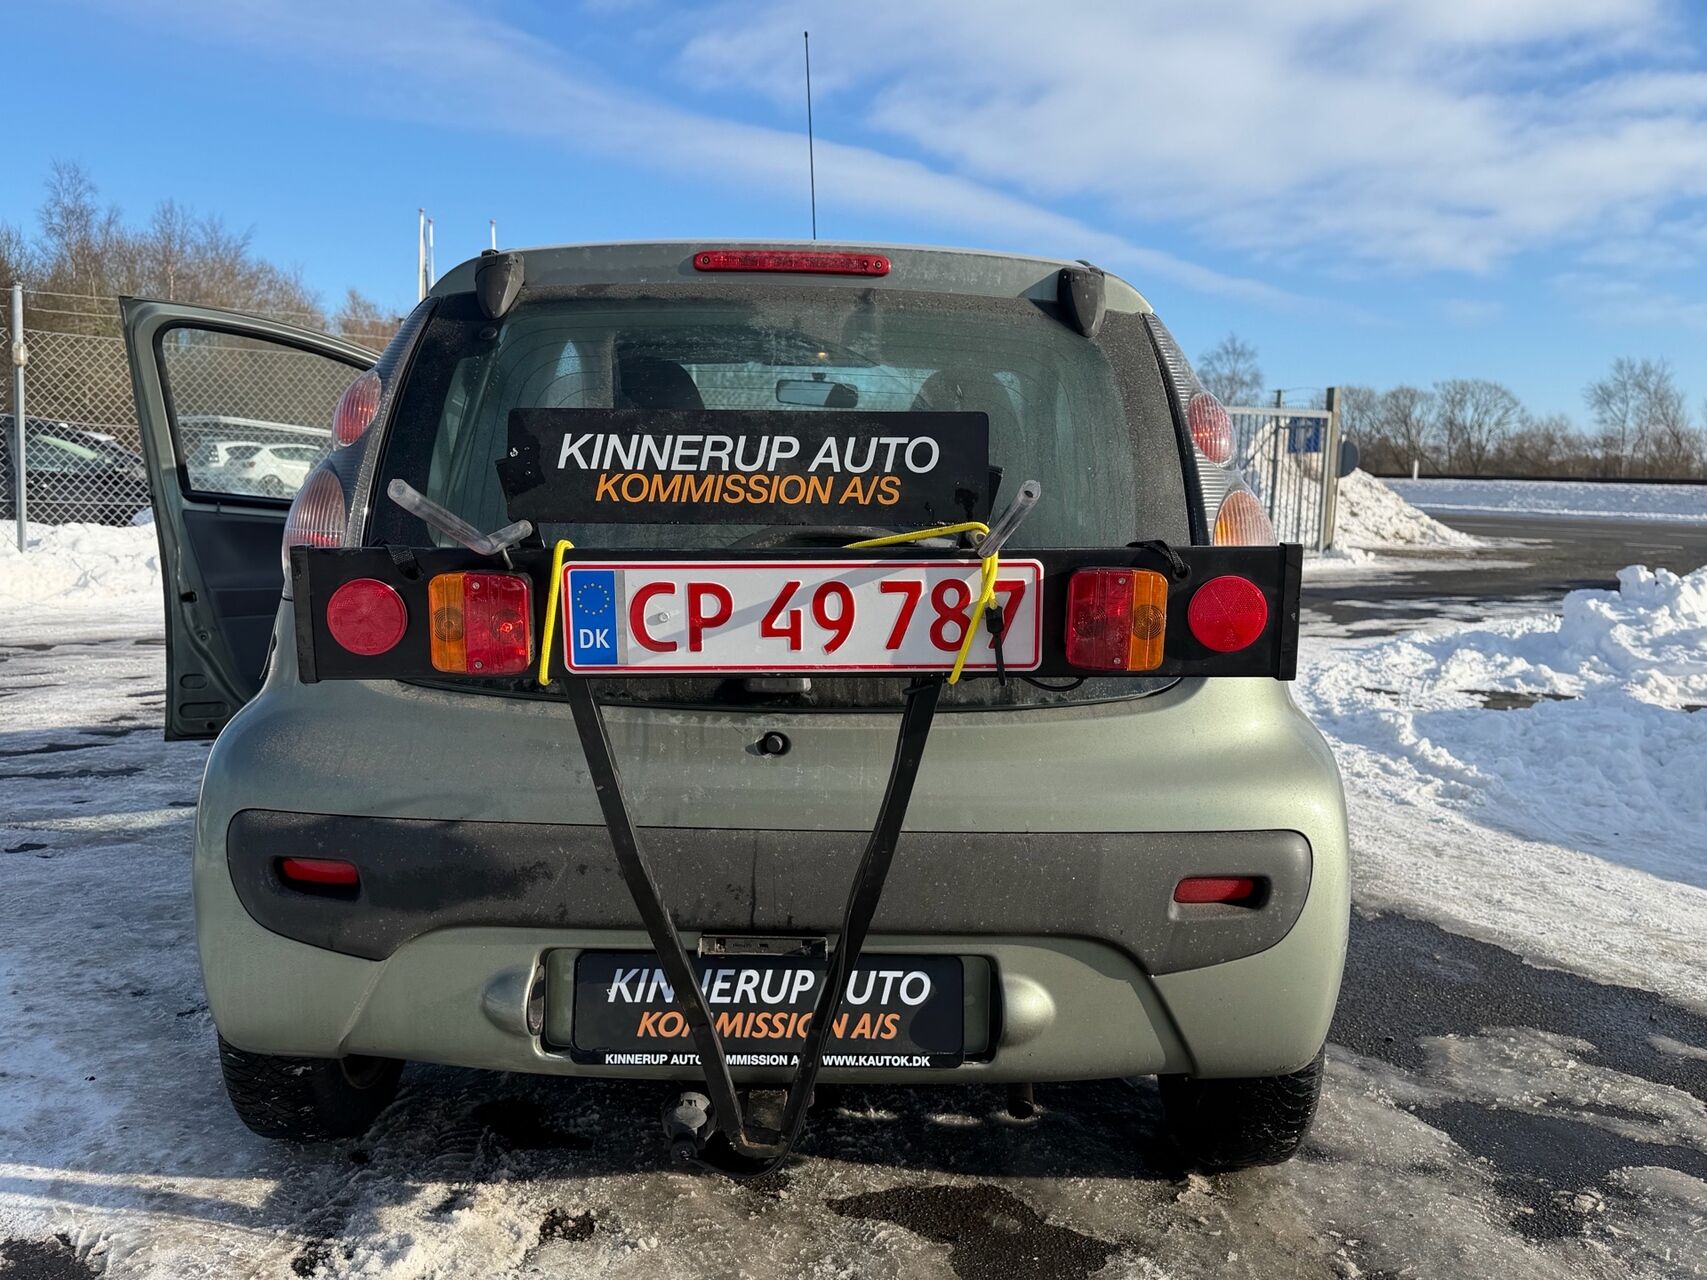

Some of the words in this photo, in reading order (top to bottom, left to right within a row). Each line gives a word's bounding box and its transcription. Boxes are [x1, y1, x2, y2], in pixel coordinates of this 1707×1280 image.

[557, 433, 800, 472] KINNERUP
[808, 437, 940, 473] AUTO
[595, 473, 836, 504] KOMMISSION
[838, 476, 902, 505] A/S
[629, 581, 734, 653] CP
[760, 578, 856, 655] 49
[880, 578, 1026, 652] 787
[579, 628, 611, 650] DK
[607, 968, 815, 1004] KINERUP
[838, 970, 931, 1006] UTO
[849, 1013, 901, 1040] A/S
[605, 1053, 668, 1065] KINNERUP
[725, 1054, 788, 1066] MMISSION
[822, 1055, 930, 1067] WWW.KAUTOK.DK
